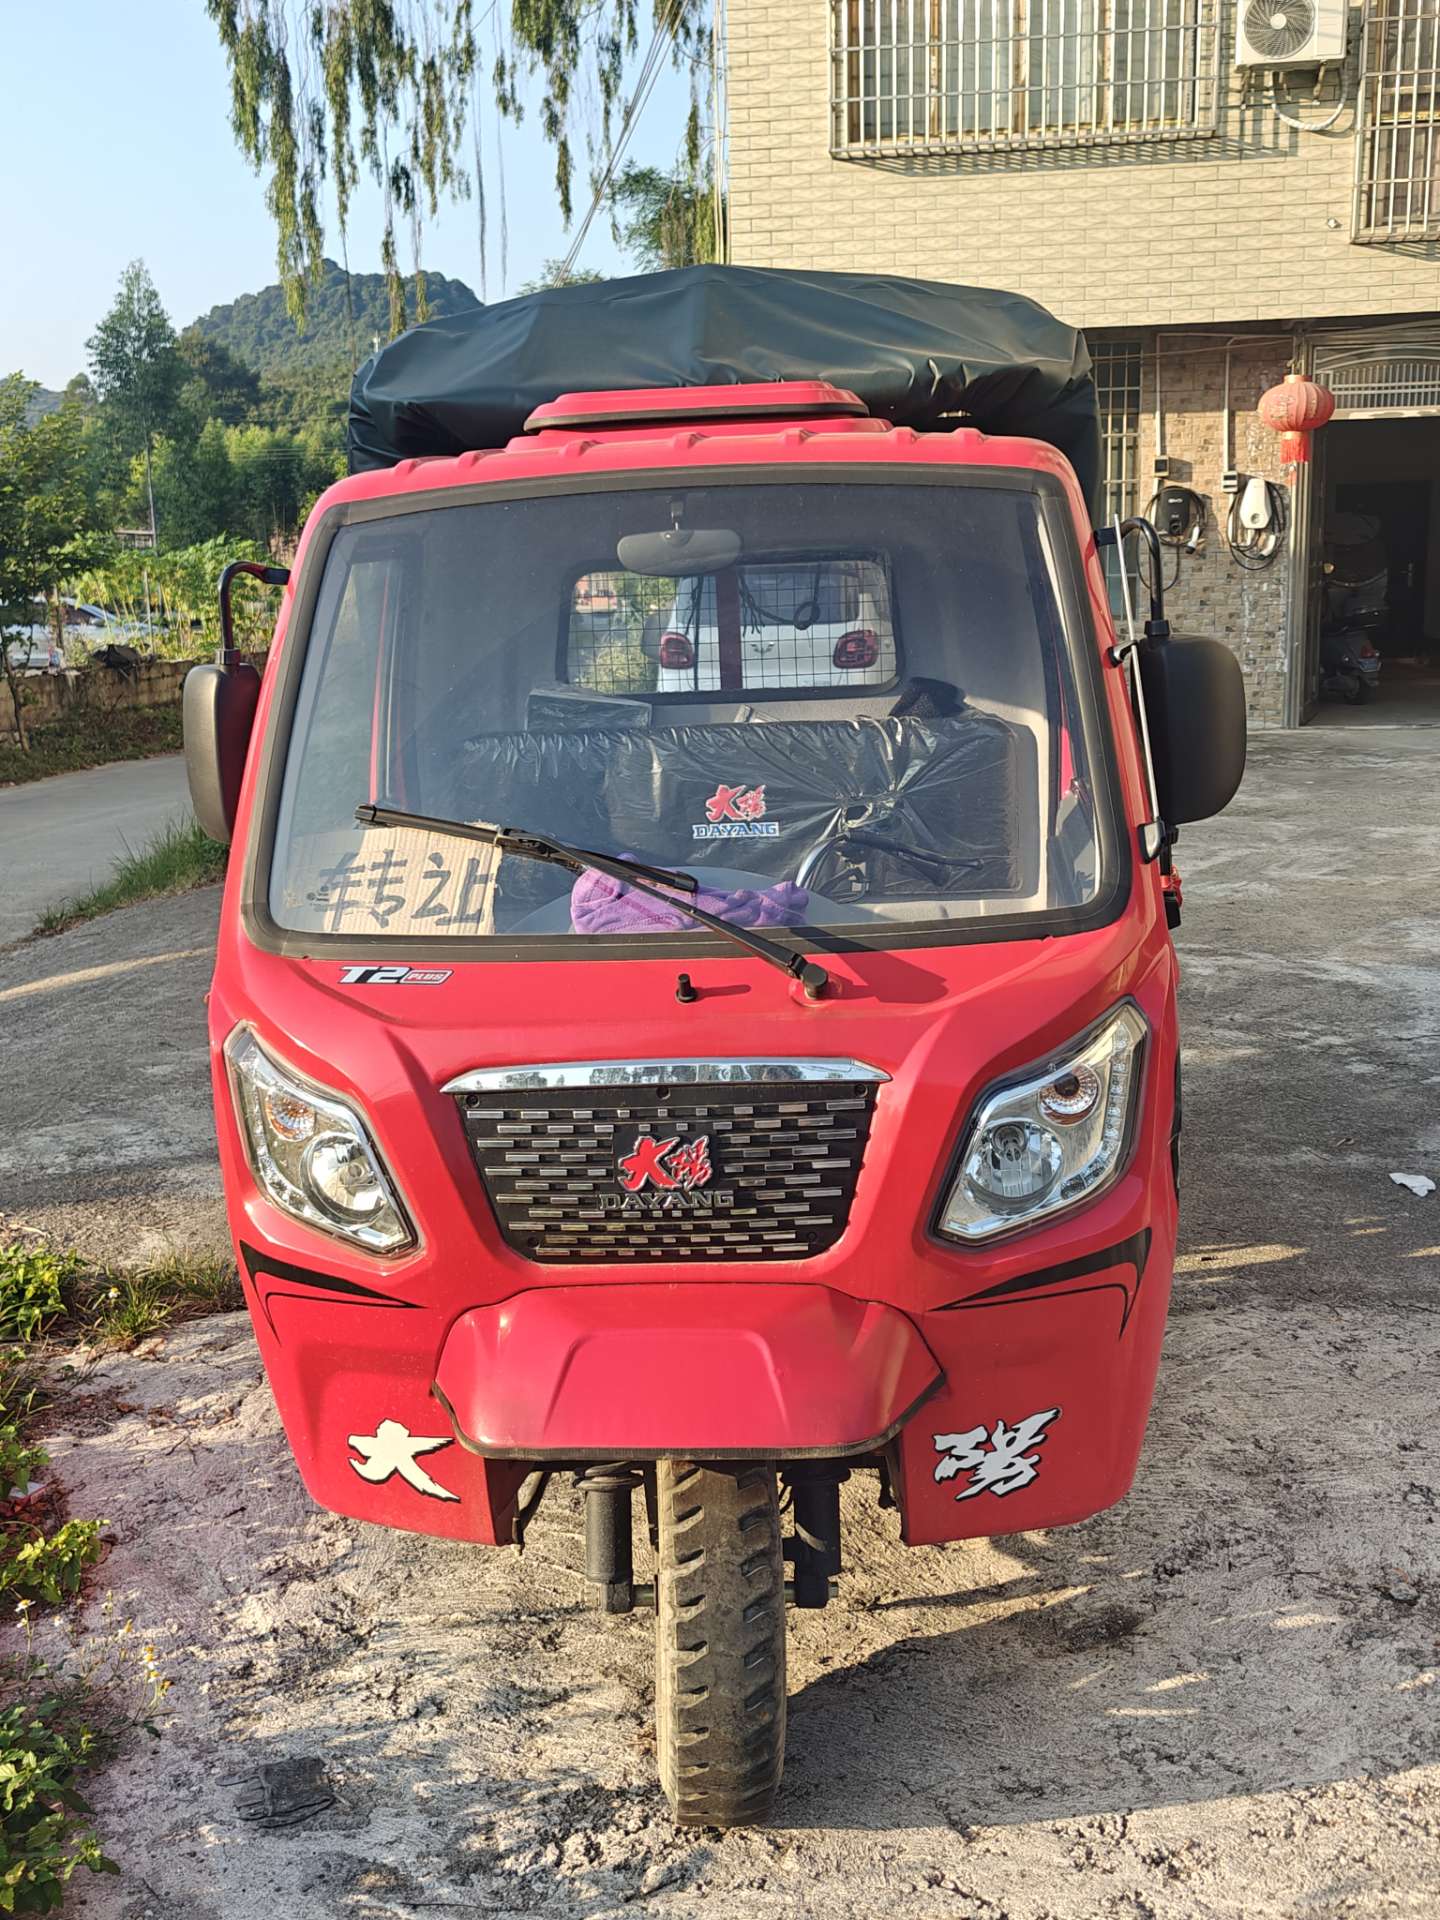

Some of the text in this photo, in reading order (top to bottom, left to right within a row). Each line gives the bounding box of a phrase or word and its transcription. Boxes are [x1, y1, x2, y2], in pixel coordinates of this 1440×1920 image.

[692, 822, 779, 839] DAYANG
[308, 849, 494, 932] 转让
[340, 966, 411, 983] T2
[599, 1190, 734, 1211] DAYANG
